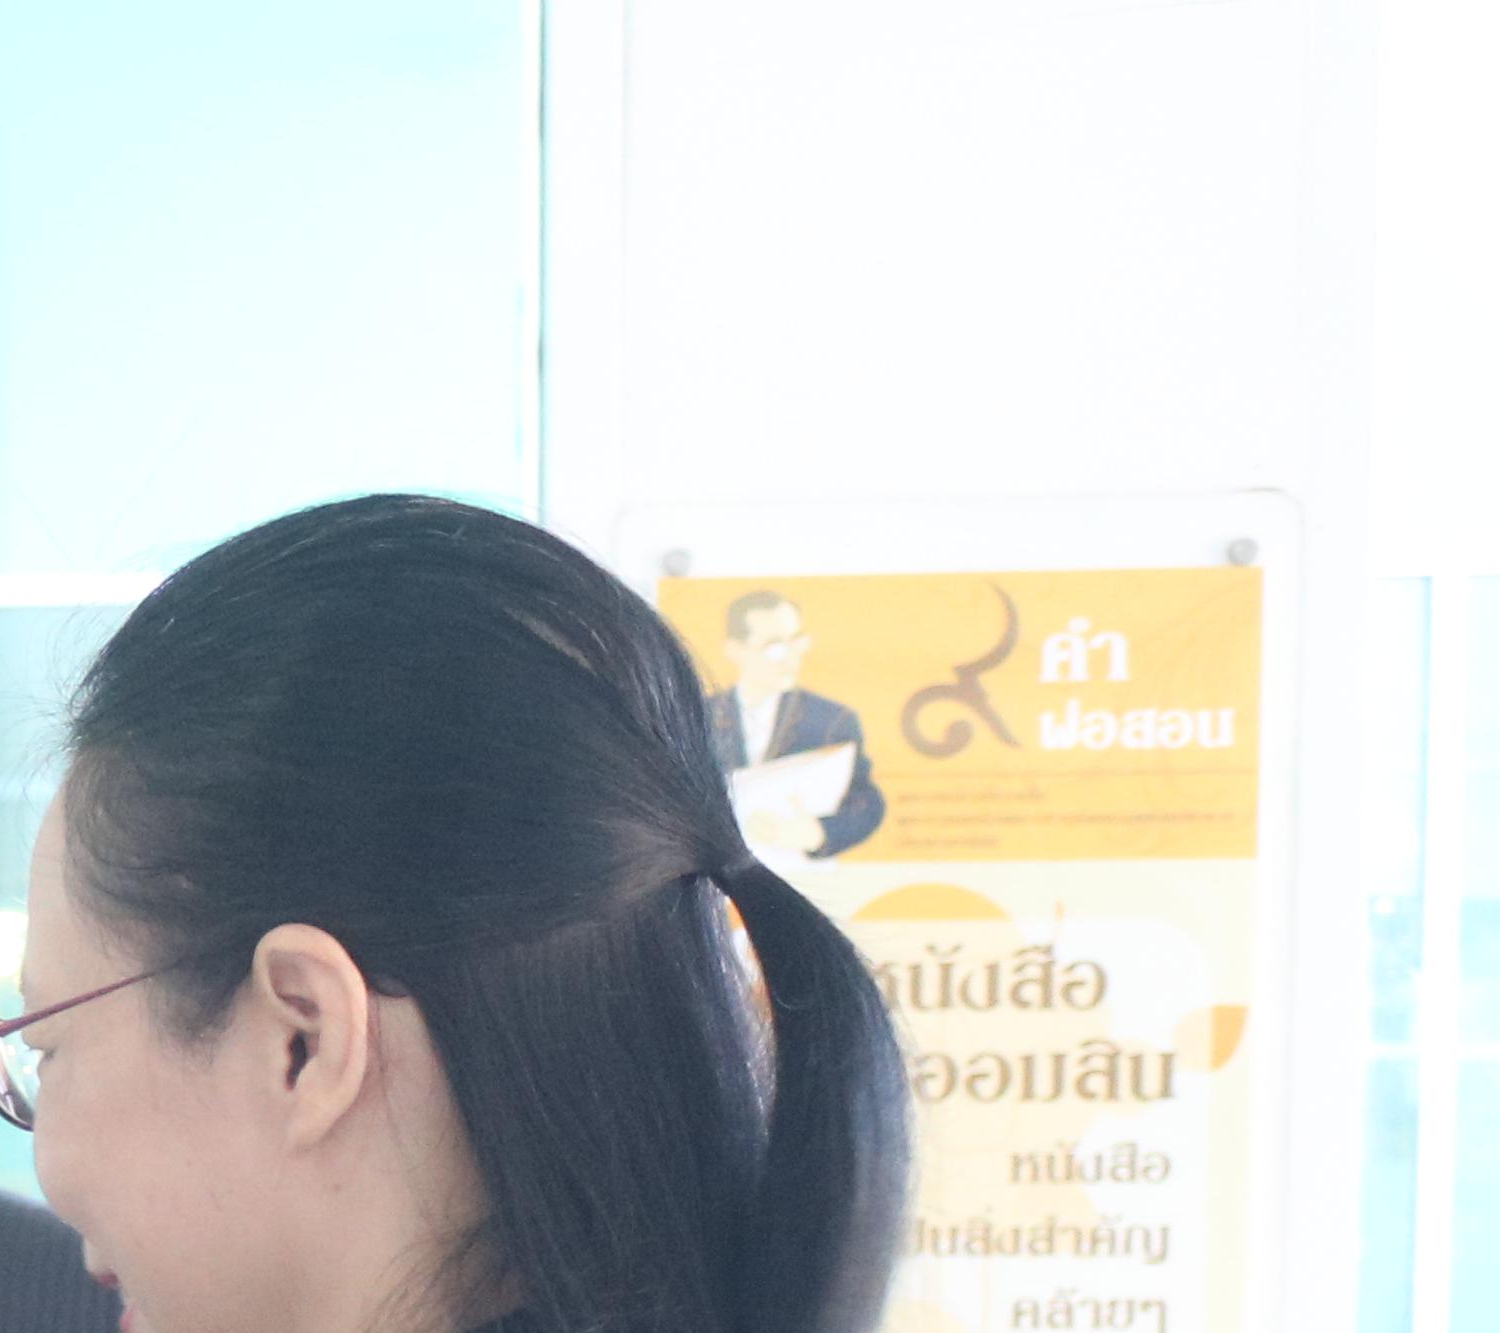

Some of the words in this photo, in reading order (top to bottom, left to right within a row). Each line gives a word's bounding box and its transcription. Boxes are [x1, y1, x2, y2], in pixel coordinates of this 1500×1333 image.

[1037, 615, 1131, 683] คำ
[911, 1039, 1177, 1104] ออมสิน
[1008, 1141, 1173, 1185] หนังสือ
